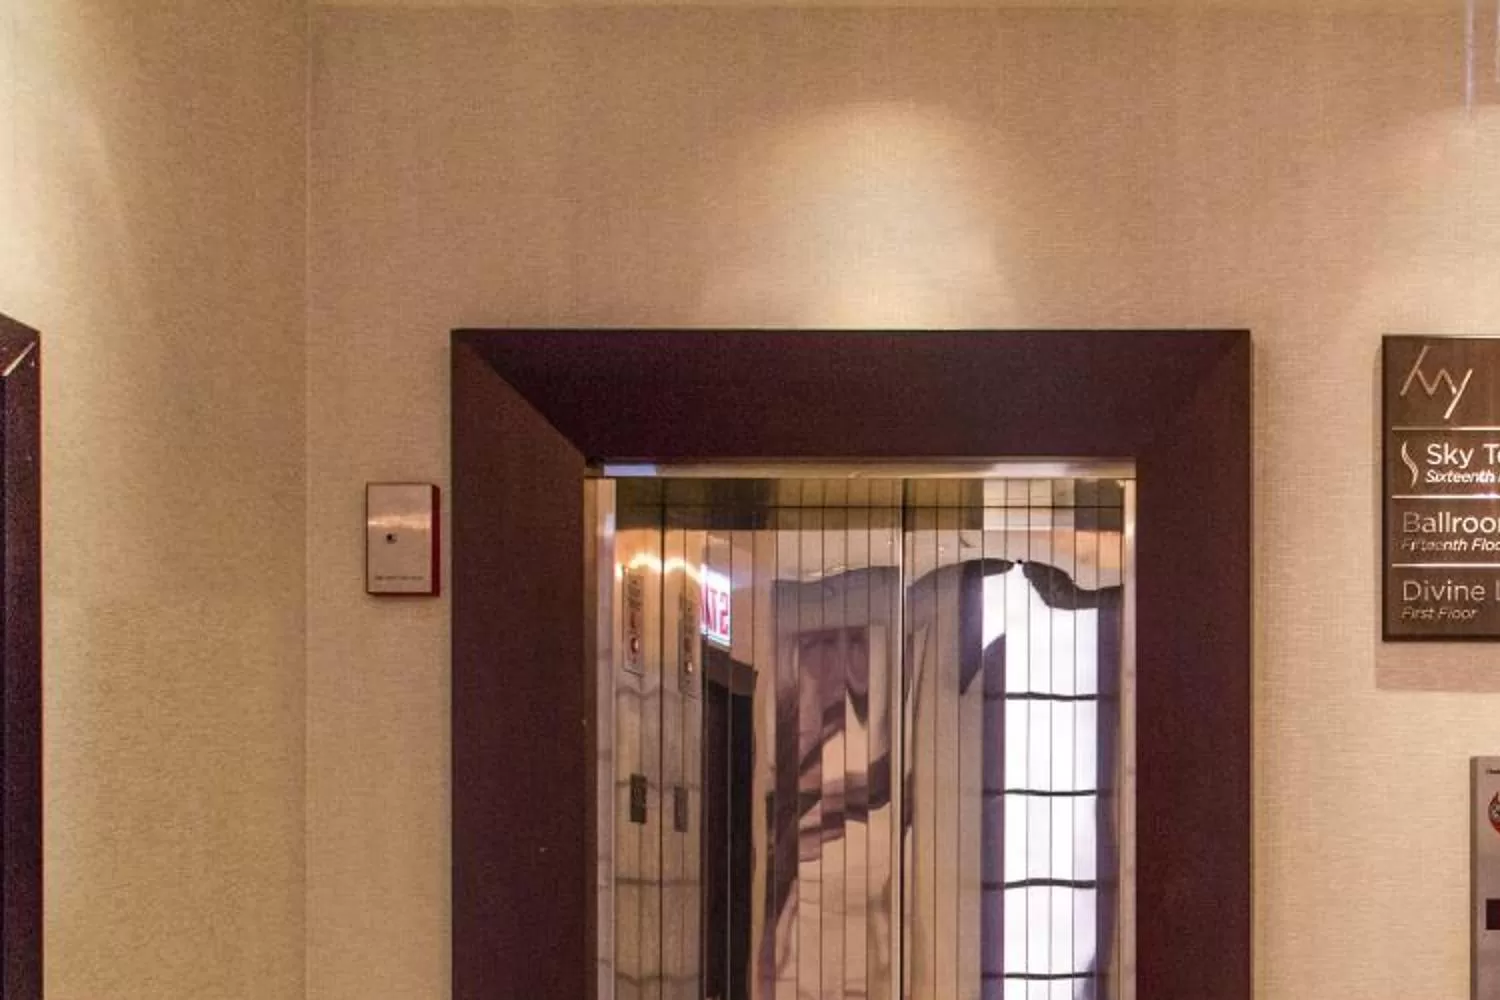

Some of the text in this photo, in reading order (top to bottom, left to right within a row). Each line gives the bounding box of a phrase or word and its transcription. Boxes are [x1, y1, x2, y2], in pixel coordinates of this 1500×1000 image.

[1426, 442, 1474, 469] Sky
[1425, 469, 1495, 483] Sixteenth
[1403, 579, 1485, 601] Divine
